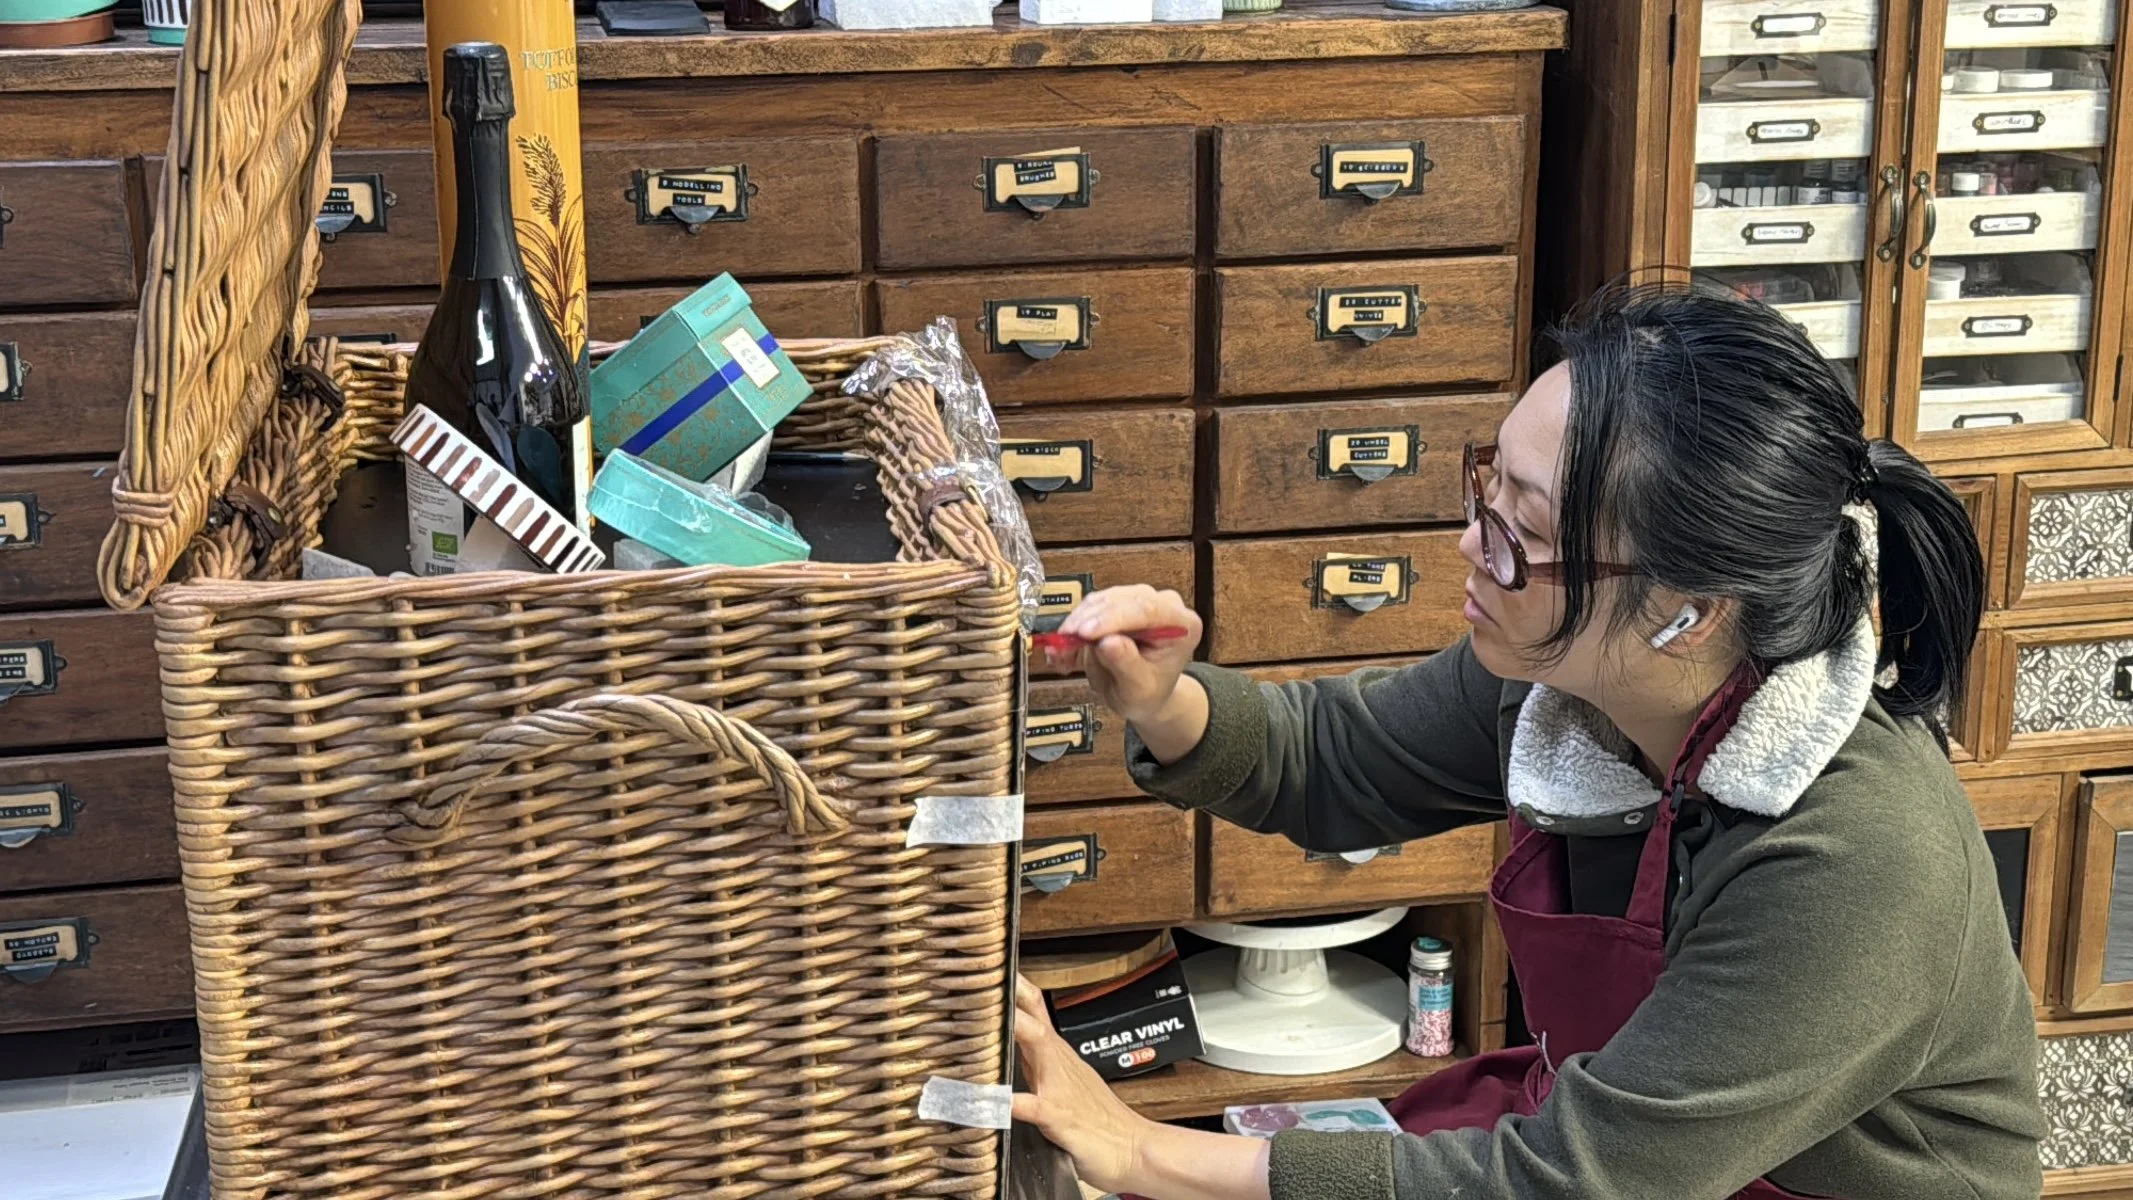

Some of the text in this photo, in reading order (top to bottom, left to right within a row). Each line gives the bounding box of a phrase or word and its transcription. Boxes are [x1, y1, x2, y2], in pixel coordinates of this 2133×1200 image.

[545, 71, 578, 91] BISC
[1080, 1017, 1185, 1055] CLEAR VINYL
[1100, 1034, 1171, 1058] POWDER FREE GLOVES
